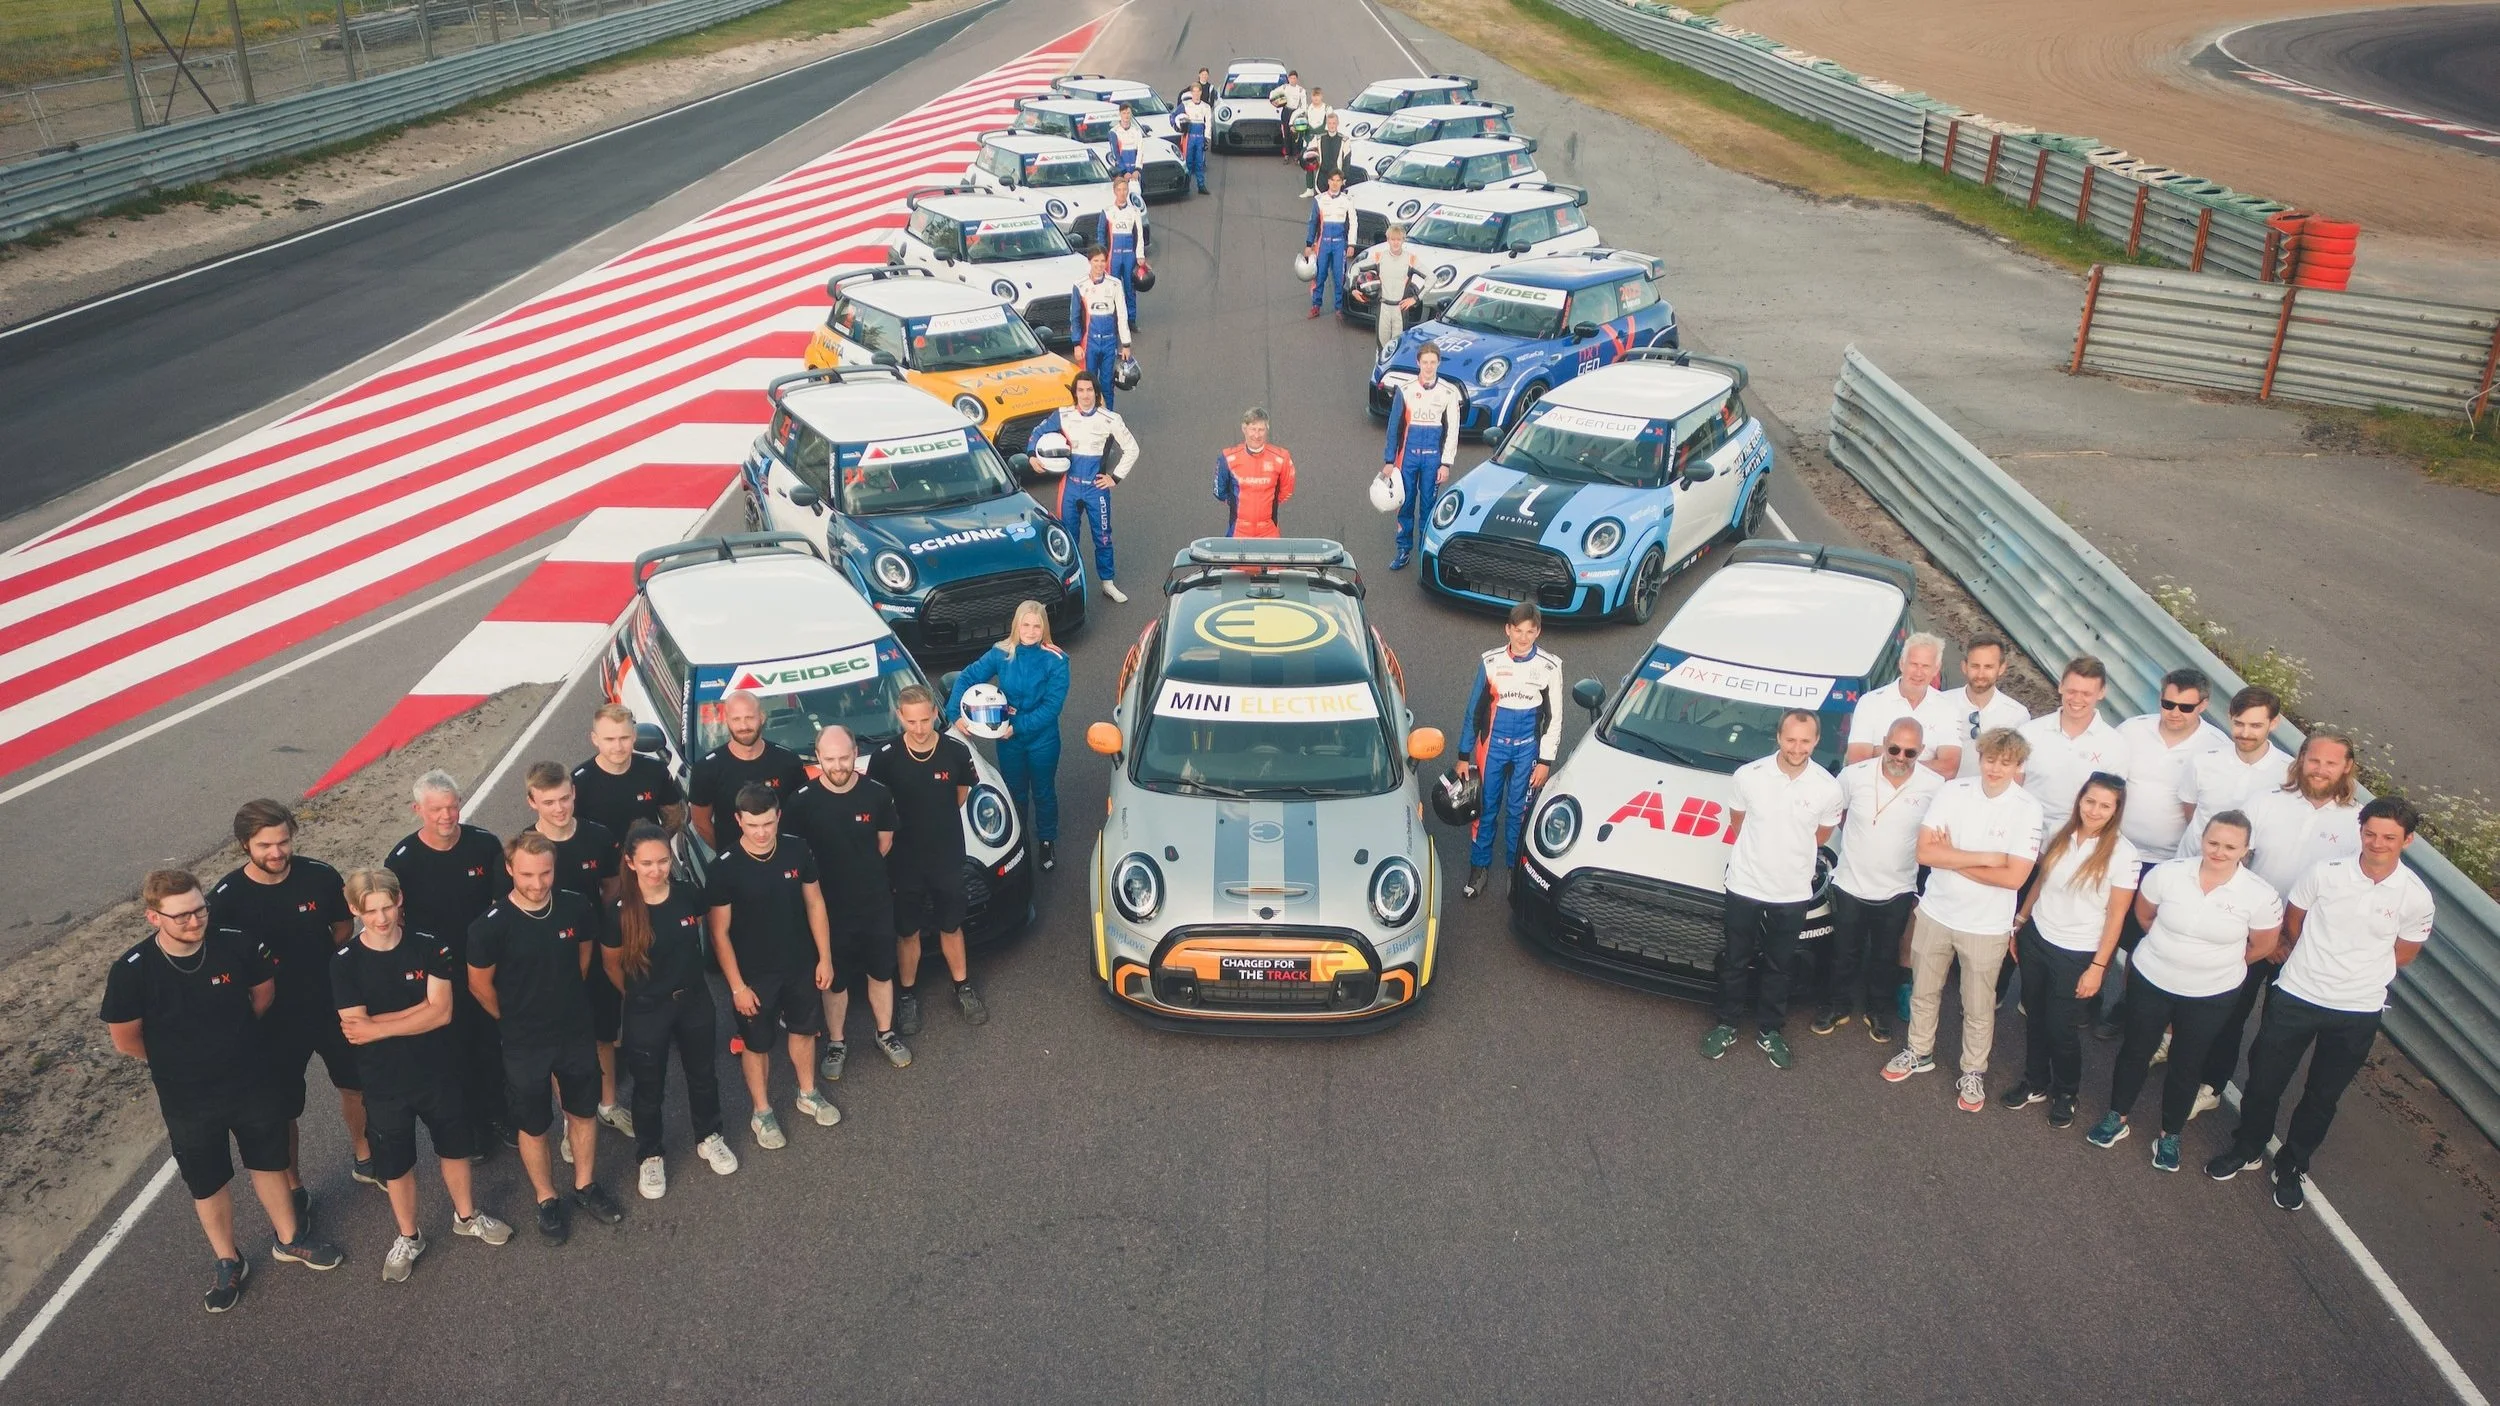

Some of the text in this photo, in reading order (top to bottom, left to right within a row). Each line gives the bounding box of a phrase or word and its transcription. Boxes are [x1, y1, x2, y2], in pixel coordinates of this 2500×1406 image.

[1440, 208, 1484, 221] VEIDEC
[992, 219, 1039, 229] VEIDEC
[1486, 284, 1547, 301] VEIDEC
[1579, 342, 1600, 362] NXT
[985, 366, 1065, 380] VARTA
[1578, 357, 1600, 376] GEN
[1413, 407, 1436, 420] dab
[1548, 412, 1575, 424] NXT
[1575, 418, 1604, 429] GEN
[1606, 422, 1637, 432] CUP
[886, 438, 962, 456] VEIDEC
[1099, 495, 1107, 514] CUP
[1496, 513, 1539, 527] tershine
[908, 527, 1007, 555] SCHUNK
[754, 657, 870, 685] VEIDEC
[1680, 665, 1723, 684] NXT
[1725, 675, 1770, 693] GEN
[1773, 684, 1818, 698] CUP
[1170, 692, 1364, 715] MINI ELECTRIC
[681, 703, 689, 745] ELECTRIC
[1222, 958, 1295, 969] CHARGED FOR
[1239, 970, 1308, 980] THE TRACK
